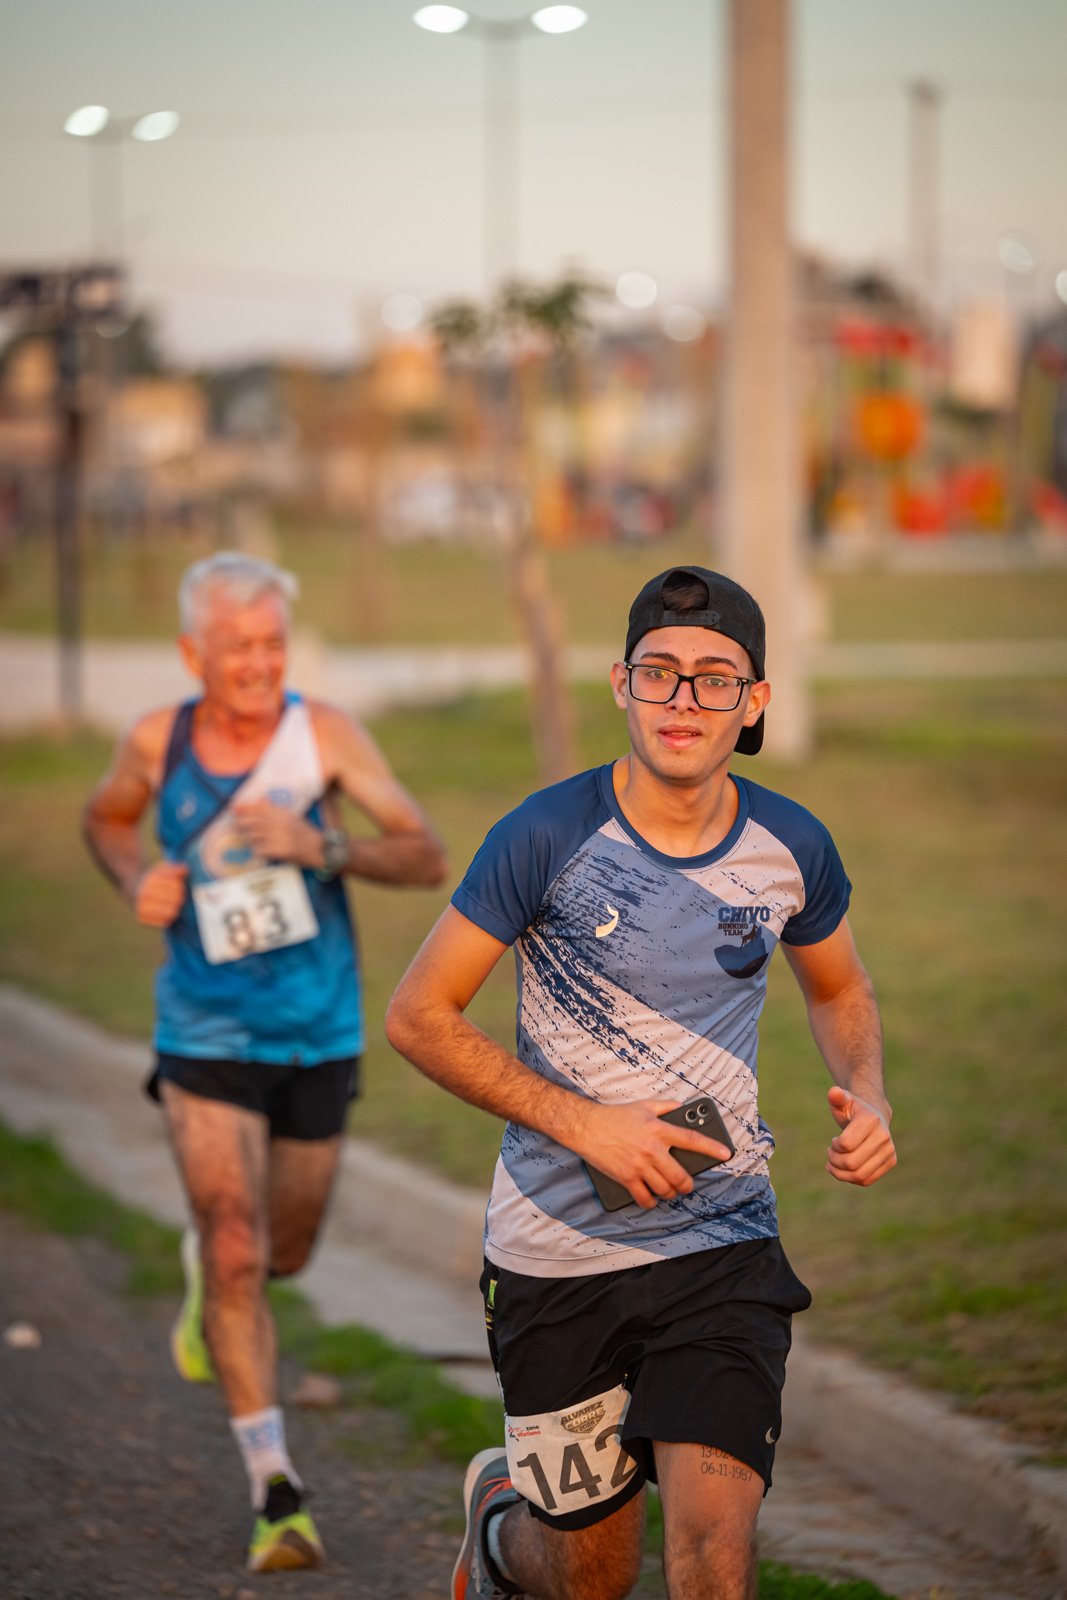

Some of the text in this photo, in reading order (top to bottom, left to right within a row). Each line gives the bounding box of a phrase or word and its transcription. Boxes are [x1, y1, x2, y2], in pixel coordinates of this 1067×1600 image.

[223, 901, 289, 951] 83
[718, 906, 770, 922] CHIVO
[561, 1400, 604, 1425] ALVAREZ
[564, 1407, 605, 1430] CORRE
[516, 1424, 640, 1510] 142
